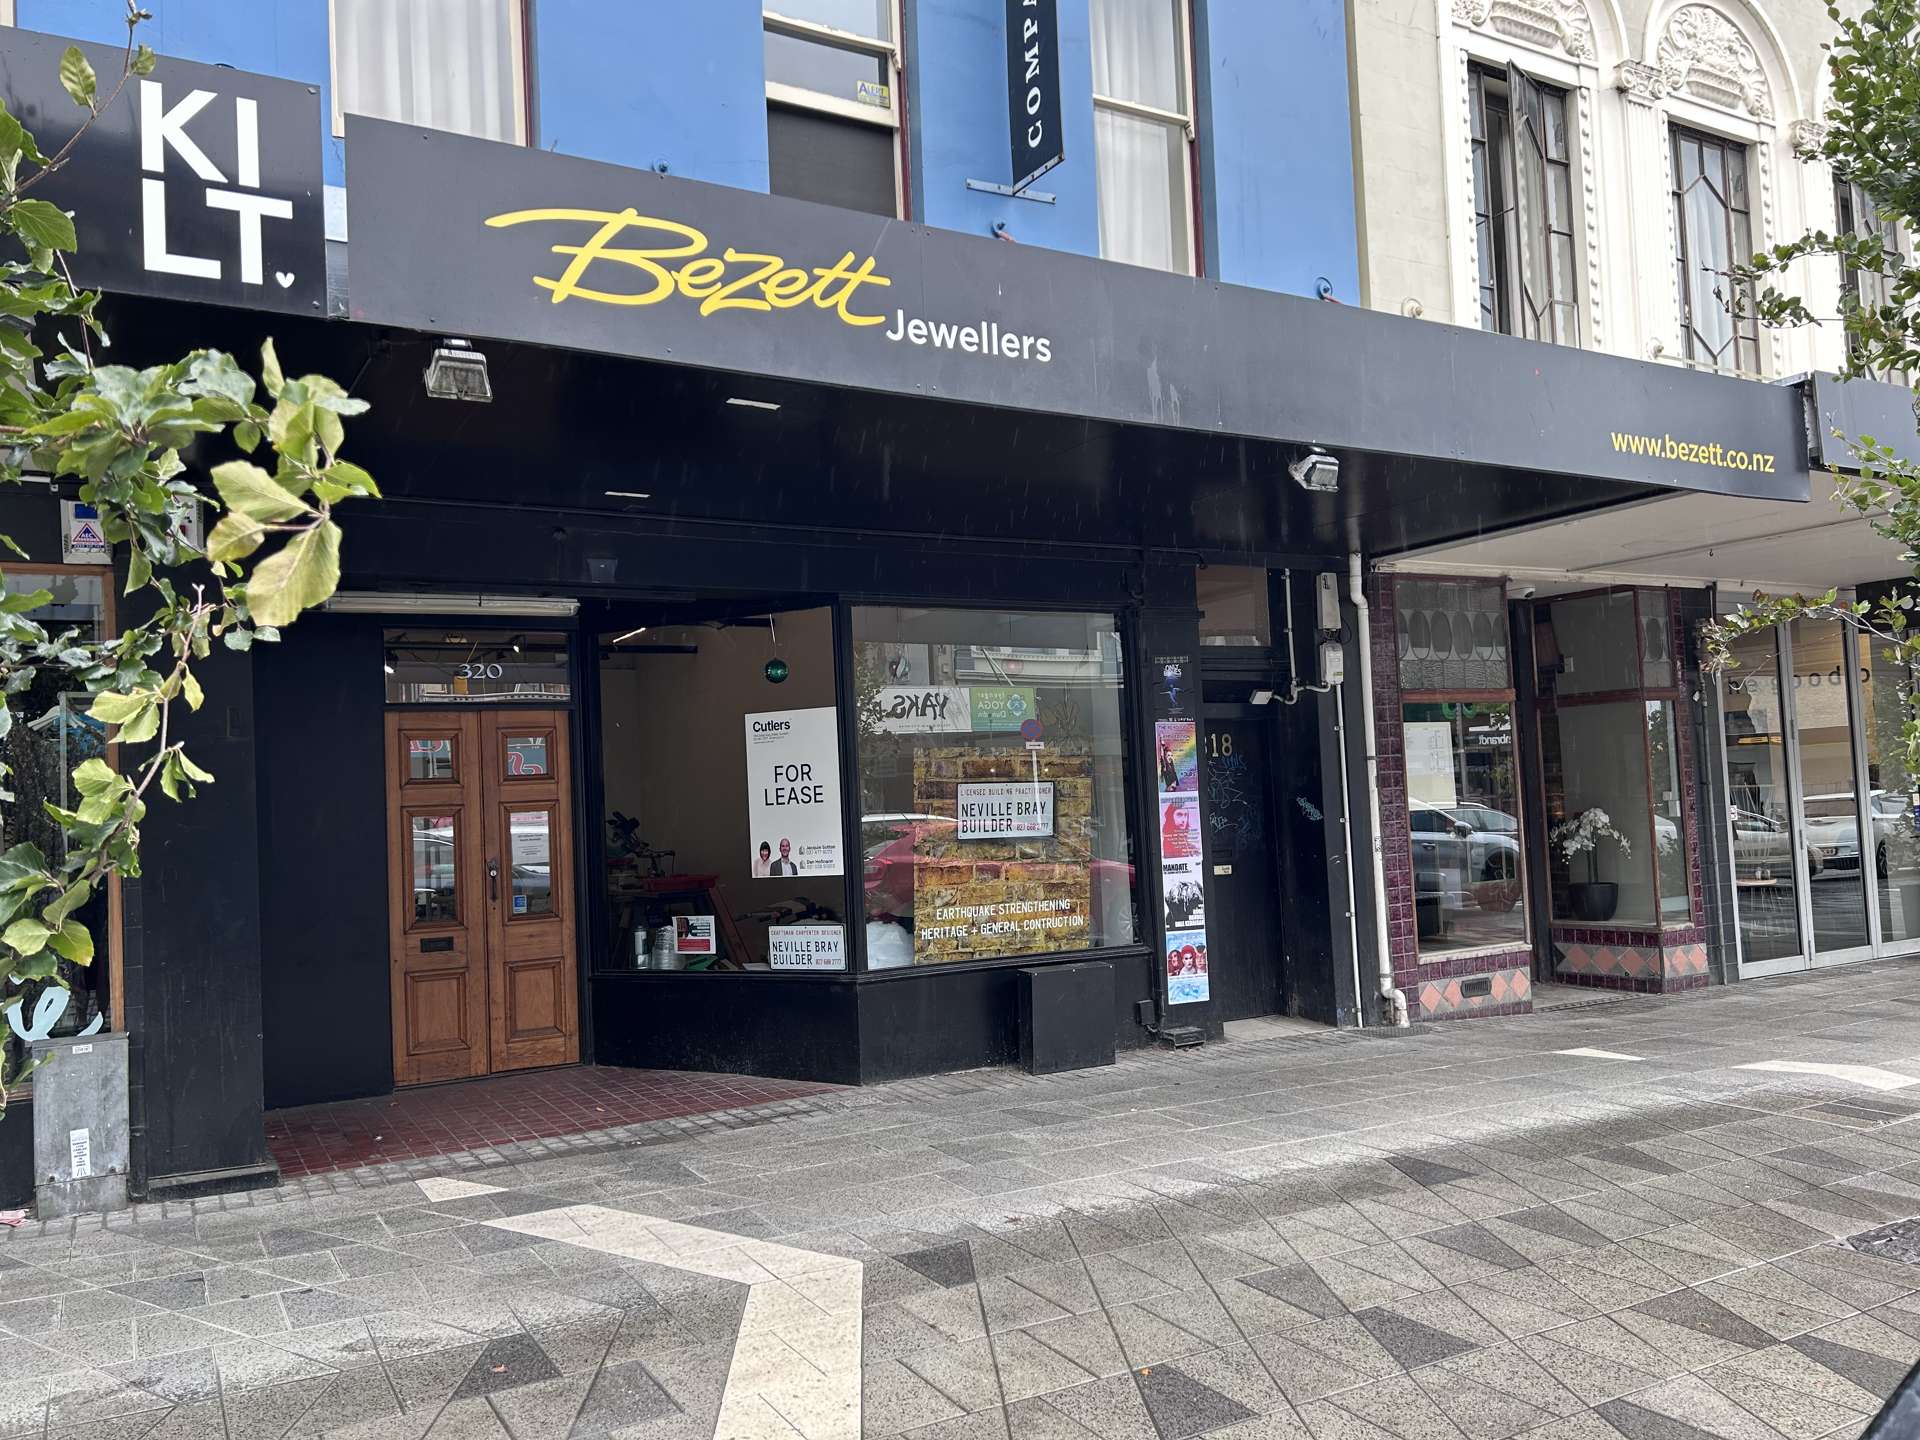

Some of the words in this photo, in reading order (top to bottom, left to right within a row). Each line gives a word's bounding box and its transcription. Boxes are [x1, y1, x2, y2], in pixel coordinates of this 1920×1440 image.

[1023, 0, 1042, 148] COMP
[485, 207, 891, 326] Bezett
[886, 309, 1052, 362] Jewellers
[1611, 431, 1776, 473] www.bezett.co.nz
[457, 663, 502, 679] 320
[752, 720, 791, 733] Cutlers
[1204, 733, 1233, 757] 18
[774, 763, 812, 783] FOR
[764, 785, 824, 806] LEASE
[961, 802, 1013, 818] NEVILLE
[1017, 801, 1046, 816] BRAY
[961, 818, 1013, 833] BUILDER
[936, 904, 997, 920] EARTHQUAKE
[998, 898, 1071, 916] STRENGTHENING
[921, 925, 968, 940] HERITAGE
[980, 919, 1021, 935] GENERAL
[1023, 914, 1084, 931] CONTRUCTION
[772, 941, 812, 953] NEVILLE
[814, 941, 839, 953] BRAY
[773, 953, 813, 965] BUILDER
